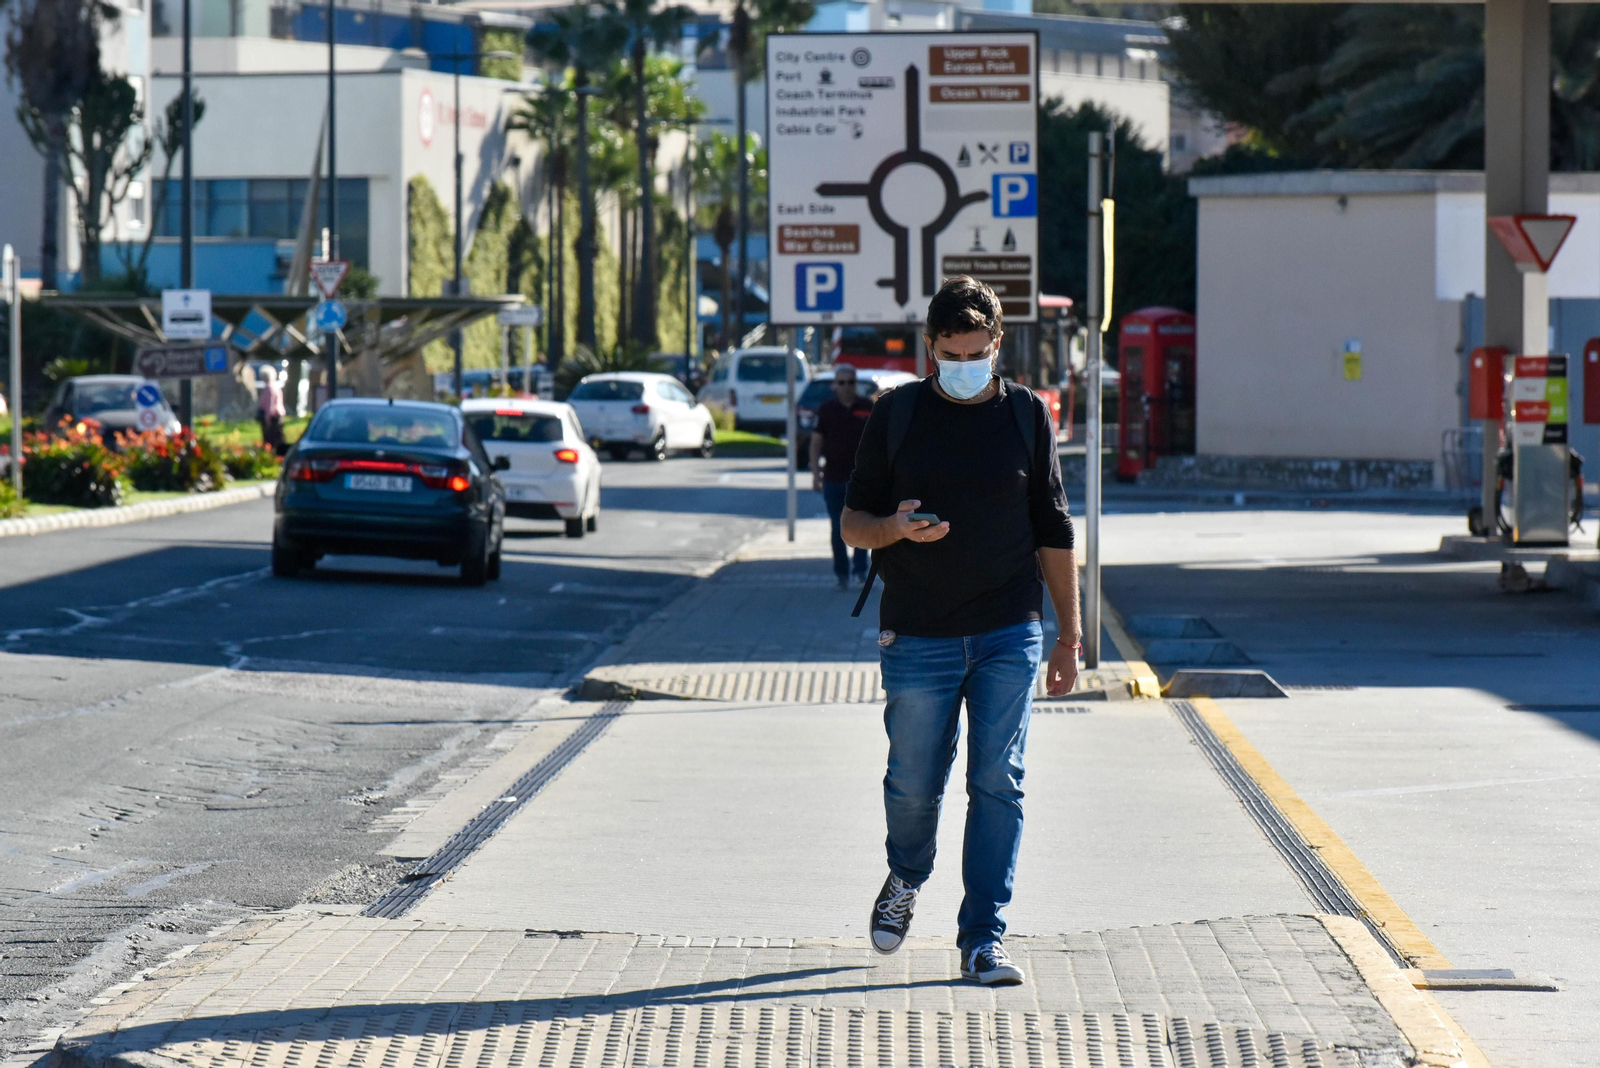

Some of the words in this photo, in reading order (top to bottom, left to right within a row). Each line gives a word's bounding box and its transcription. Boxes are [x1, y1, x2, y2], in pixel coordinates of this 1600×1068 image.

[775, 51, 800, 64] City
[803, 50, 846, 62] Centre
[943, 46, 978, 61] Upper
[980, 46, 1009, 59] Rock
[943, 60, 984, 74] Europa
[986, 60, 1016, 73] Point
[775, 70, 802, 82] Port
[775, 88, 814, 100] Coach
[818, 88, 873, 100] Terminus
[941, 86, 978, 99] Ocean
[980, 86, 1019, 101] Village
[775, 105, 835, 117] Industrial
[838, 104, 866, 117] Park
[776, 122, 812, 135] Cable
[815, 123, 836, 135] Car
[1013, 144, 1027, 163] P
[1000, 176, 1029, 215] P
[777, 203, 804, 215] East
[809, 202, 836, 215] Side
[783, 226, 836, 239] Beaches
[783, 241, 808, 252] War
[811, 240, 856, 253] Graves
[943, 259, 971, 271] World
[973, 260, 998, 271] Trade
[806, 265, 838, 308] P
